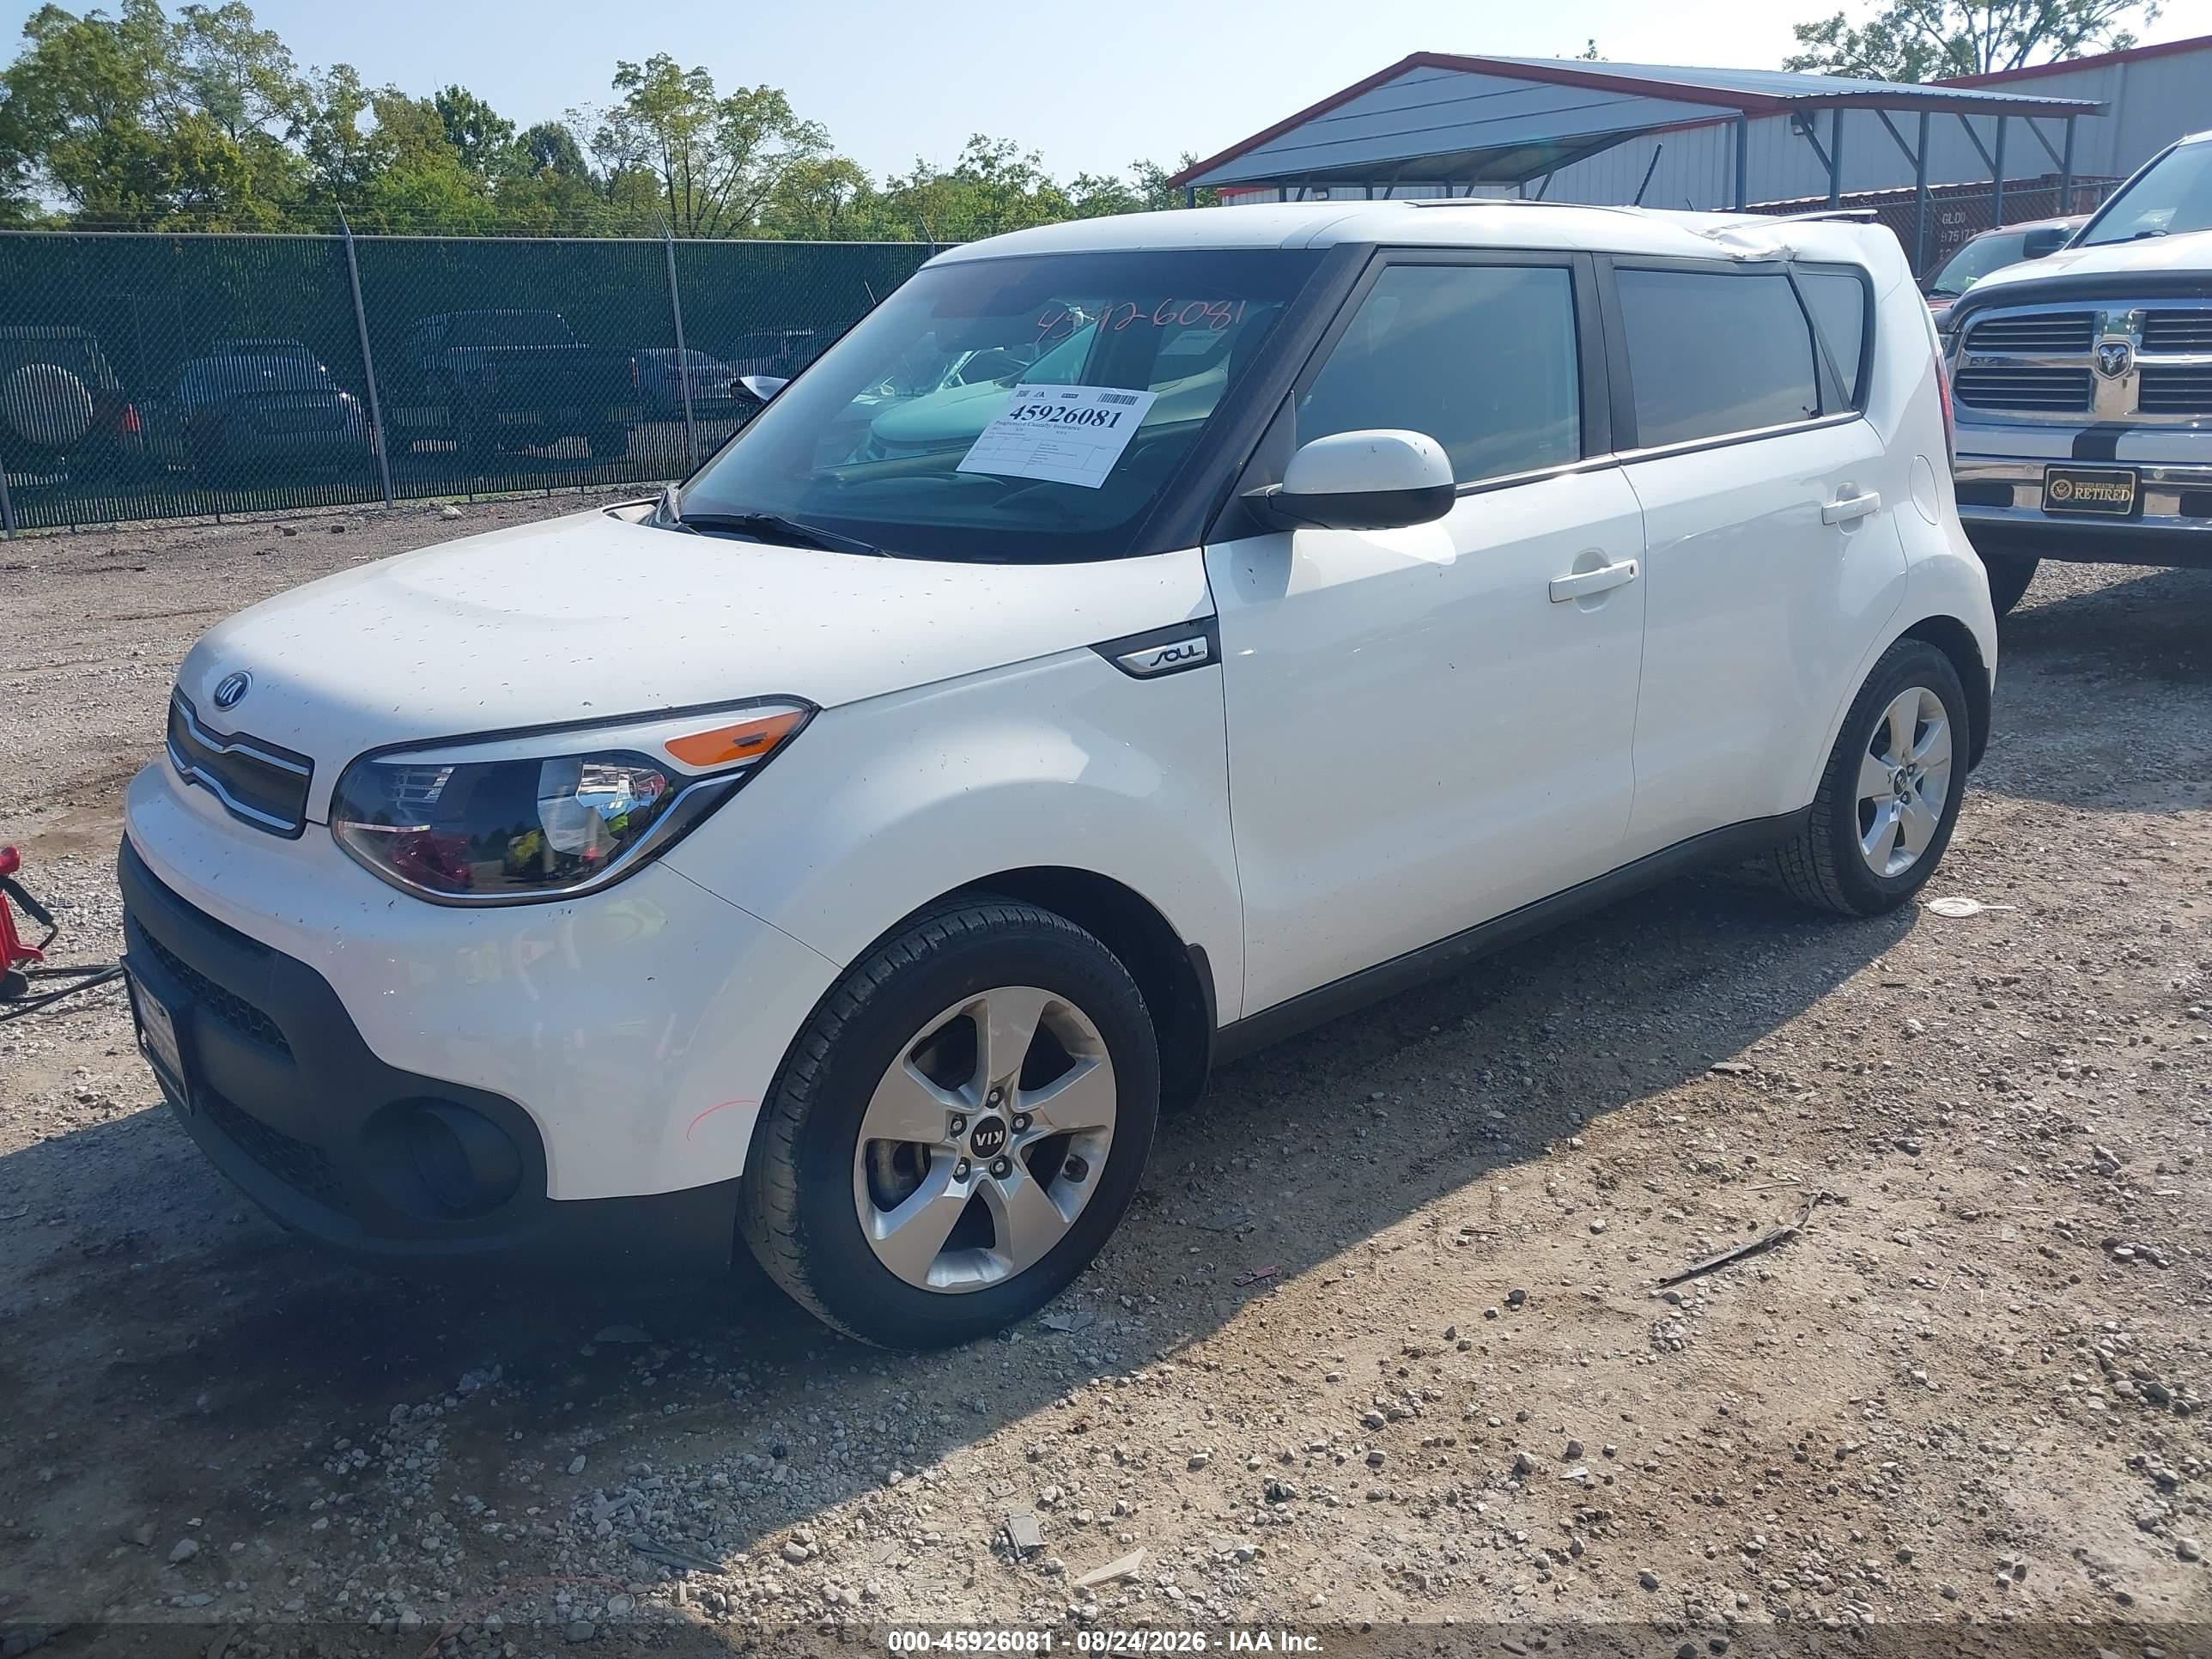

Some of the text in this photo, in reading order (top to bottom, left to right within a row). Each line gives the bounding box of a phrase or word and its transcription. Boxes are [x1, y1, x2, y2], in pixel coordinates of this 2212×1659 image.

[1009, 404, 1124, 429] 45926081
[2075, 487, 2130, 501] RETIRED
[1149, 644, 1206, 667] SOUL
[975, 1130, 1004, 1146] KIA
